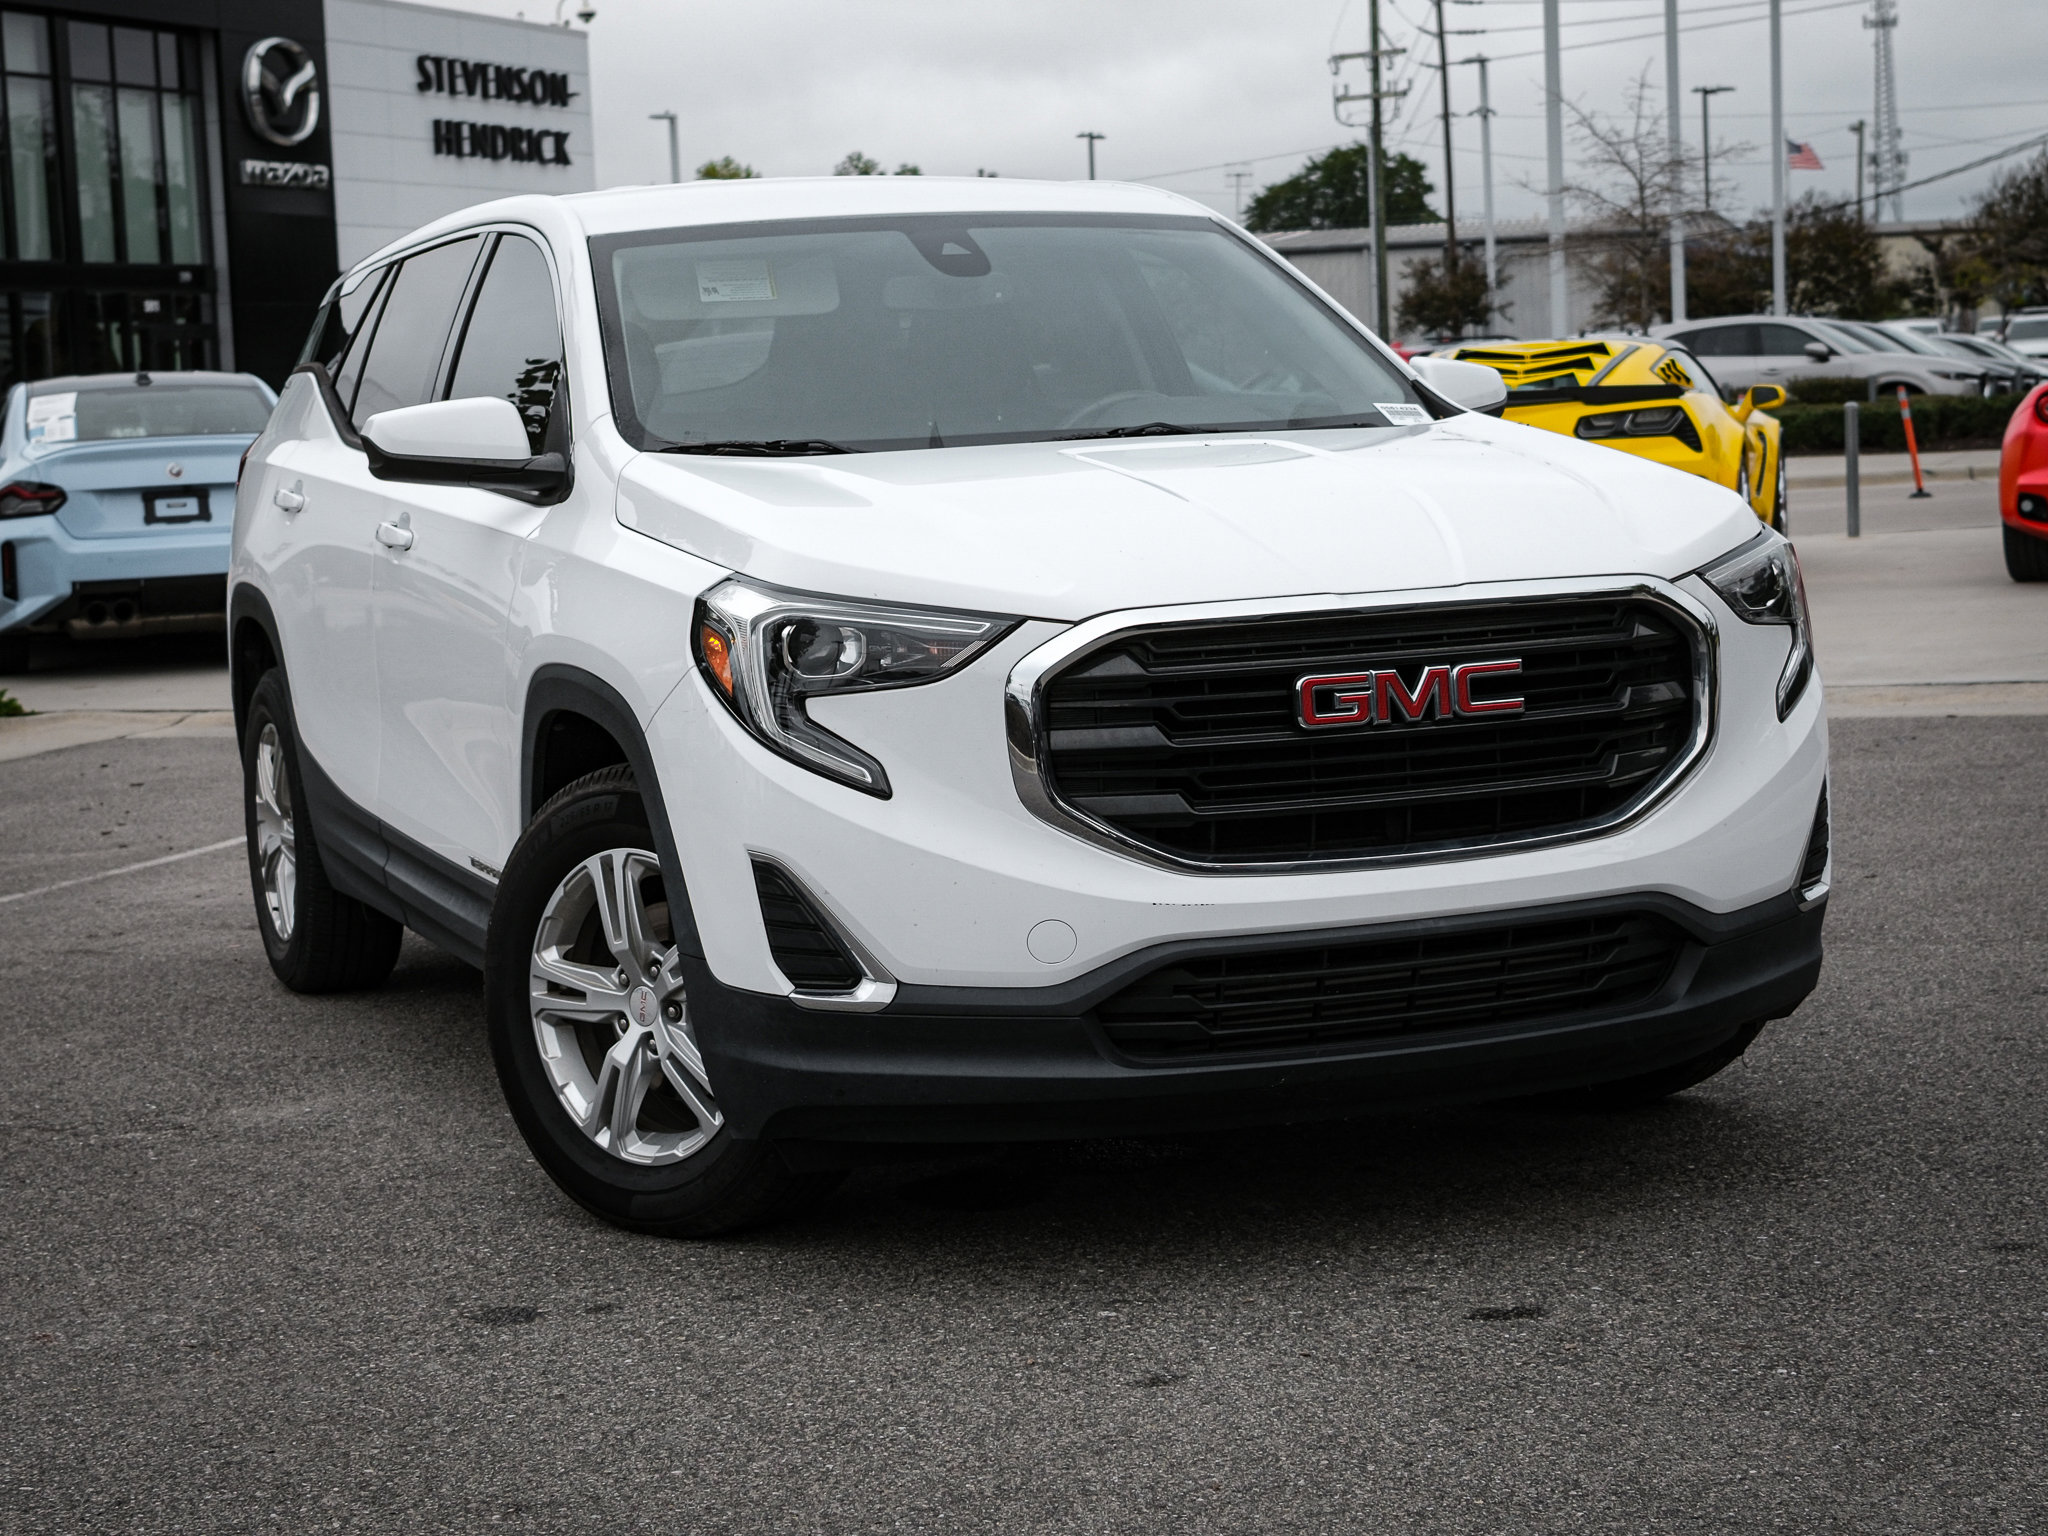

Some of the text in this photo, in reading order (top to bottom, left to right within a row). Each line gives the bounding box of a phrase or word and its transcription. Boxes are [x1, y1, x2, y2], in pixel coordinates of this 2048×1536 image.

[432, 118, 573, 167] HENDRICK
[242, 158, 330, 188] mazda
[1296, 658, 1526, 730] GMC
[639, 990, 648, 1023] GMC
